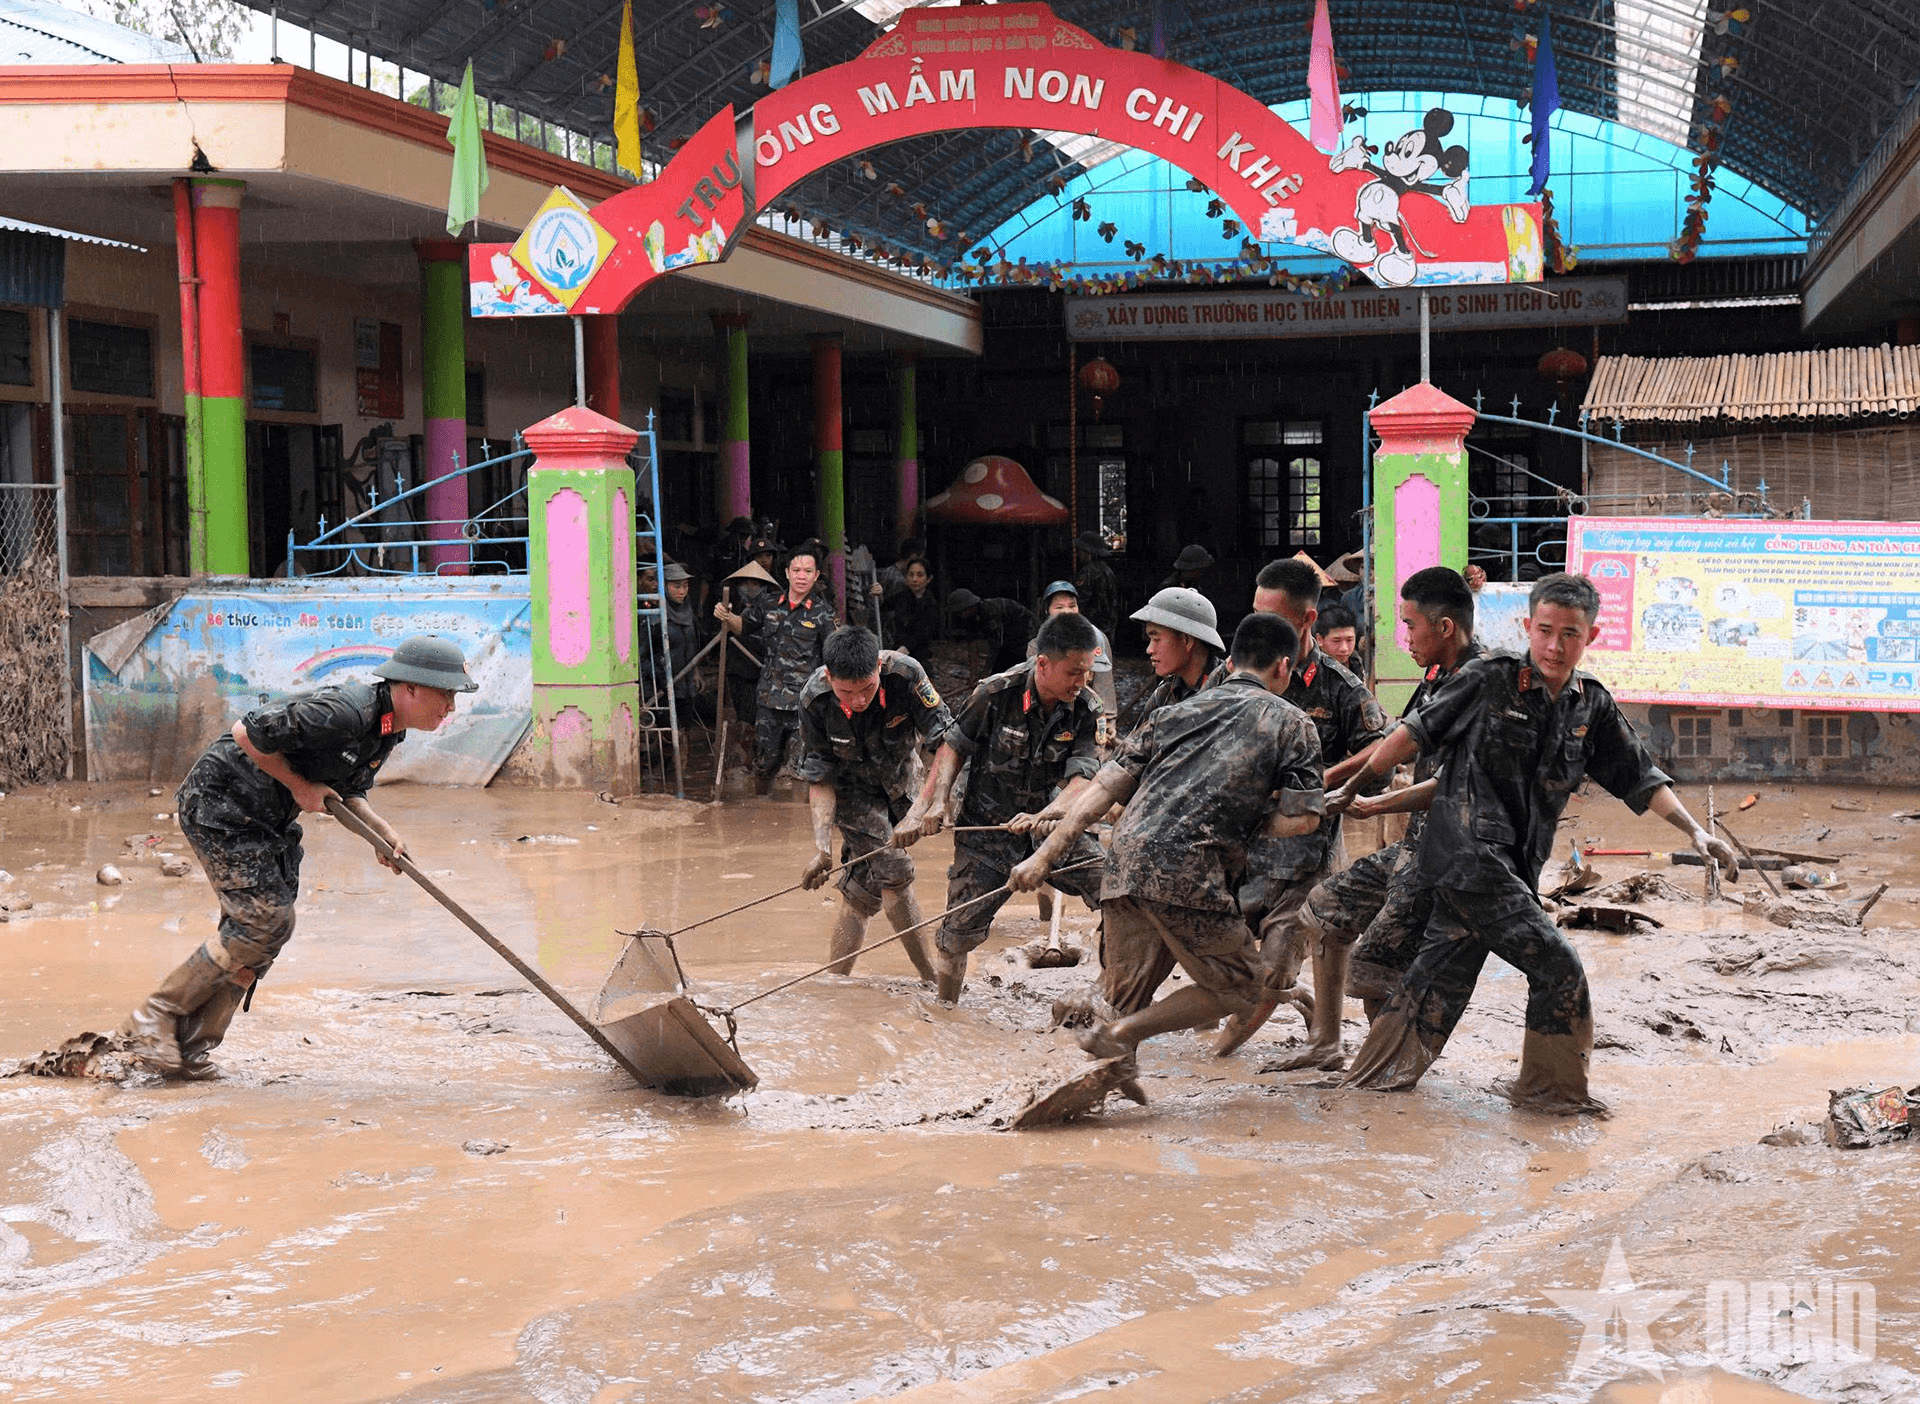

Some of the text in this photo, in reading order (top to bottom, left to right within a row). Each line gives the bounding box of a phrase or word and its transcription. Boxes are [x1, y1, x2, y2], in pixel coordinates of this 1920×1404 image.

[857, 56, 976, 116] MẦM
[1004, 67, 1105, 110] NON
[1125, 87, 1204, 142] CHI
[1217, 131, 1304, 207] KHÊ
[1107, 302, 1138, 325] XÂY
[1143, 304, 1189, 328] DỰNG
[1263, 302, 1297, 326] HỌC
[1351, 294, 1400, 321] THIỆN
[1457, 293, 1498, 314] SINH
[1504, 289, 1542, 312] TÍCH
[1848, 541, 1866, 552] AN
[1868, 538, 1900, 553] TOÀN
